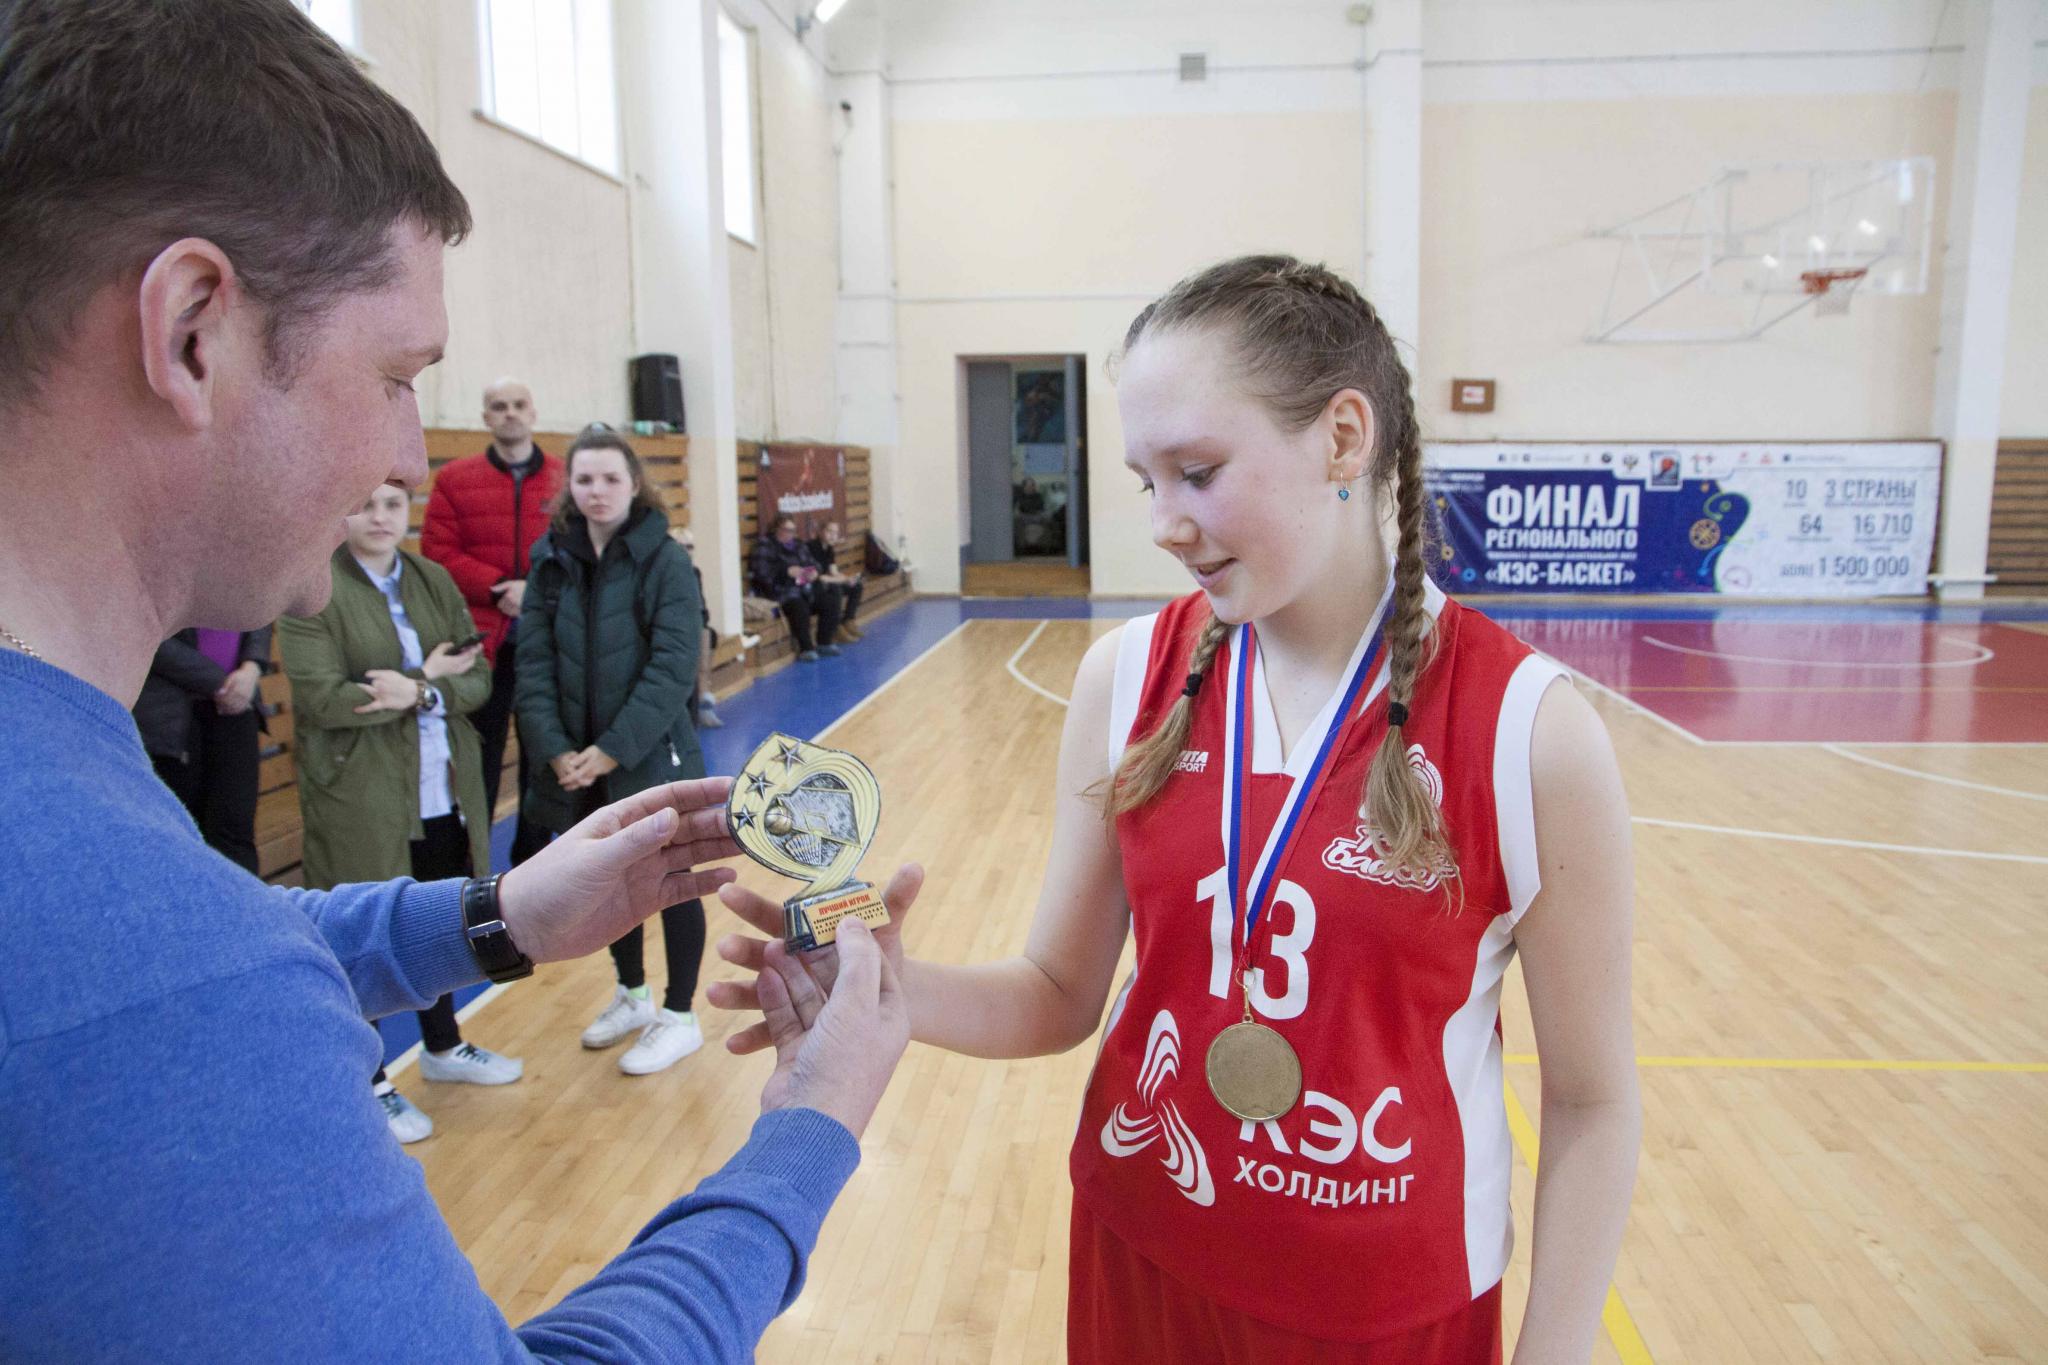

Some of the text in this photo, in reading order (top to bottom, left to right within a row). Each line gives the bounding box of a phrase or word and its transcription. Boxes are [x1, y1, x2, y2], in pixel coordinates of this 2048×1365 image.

[1786, 479, 1808, 499] 10
[1825, 479, 1917, 499] 3 СТРАНЫ
[1486, 484, 1640, 528] ФИНАЛ
[1800, 513, 1823, 534] 64
[1485, 528, 1638, 550] РЕГИОНАЛЬНОГО
[1484, 561, 1636, 585] «КЭС-БАСКЕТ»
[1196, 864, 1317, 1020] 13
[1233, 1155, 1415, 1209] ХОЛДИНГ
